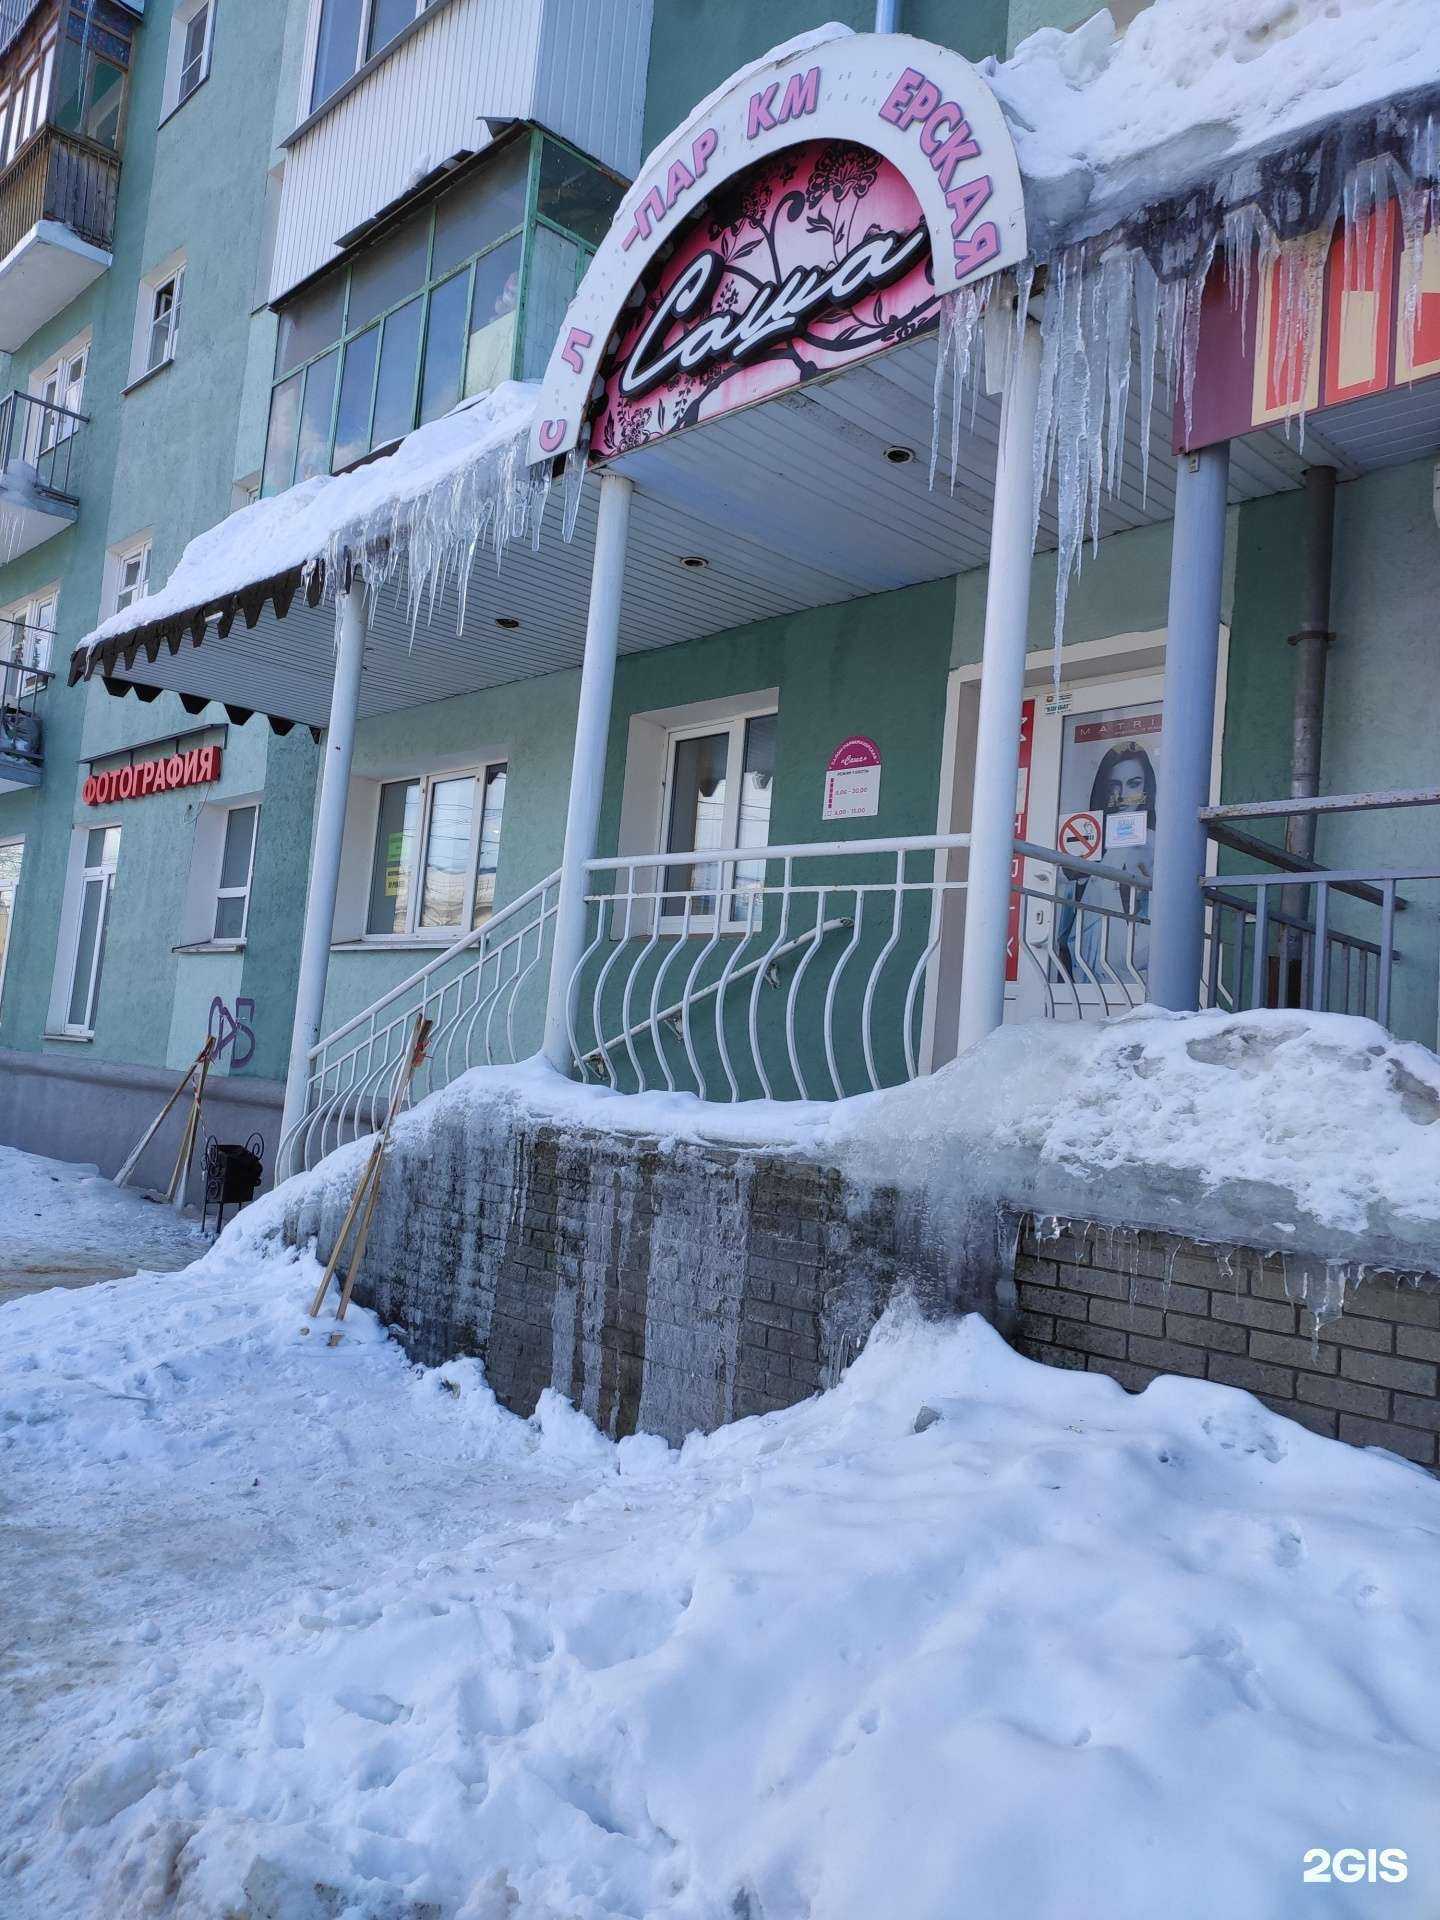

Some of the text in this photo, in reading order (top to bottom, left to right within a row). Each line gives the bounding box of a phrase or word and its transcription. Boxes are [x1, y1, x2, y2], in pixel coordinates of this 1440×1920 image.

[746, 66, 823, 139] КМ
[878, 67, 1002, 278] ЕРСКАЯ
[621, 226, 930, 395] Саша
[83, 746, 215, 805] ФОТОГРАФИЯ
